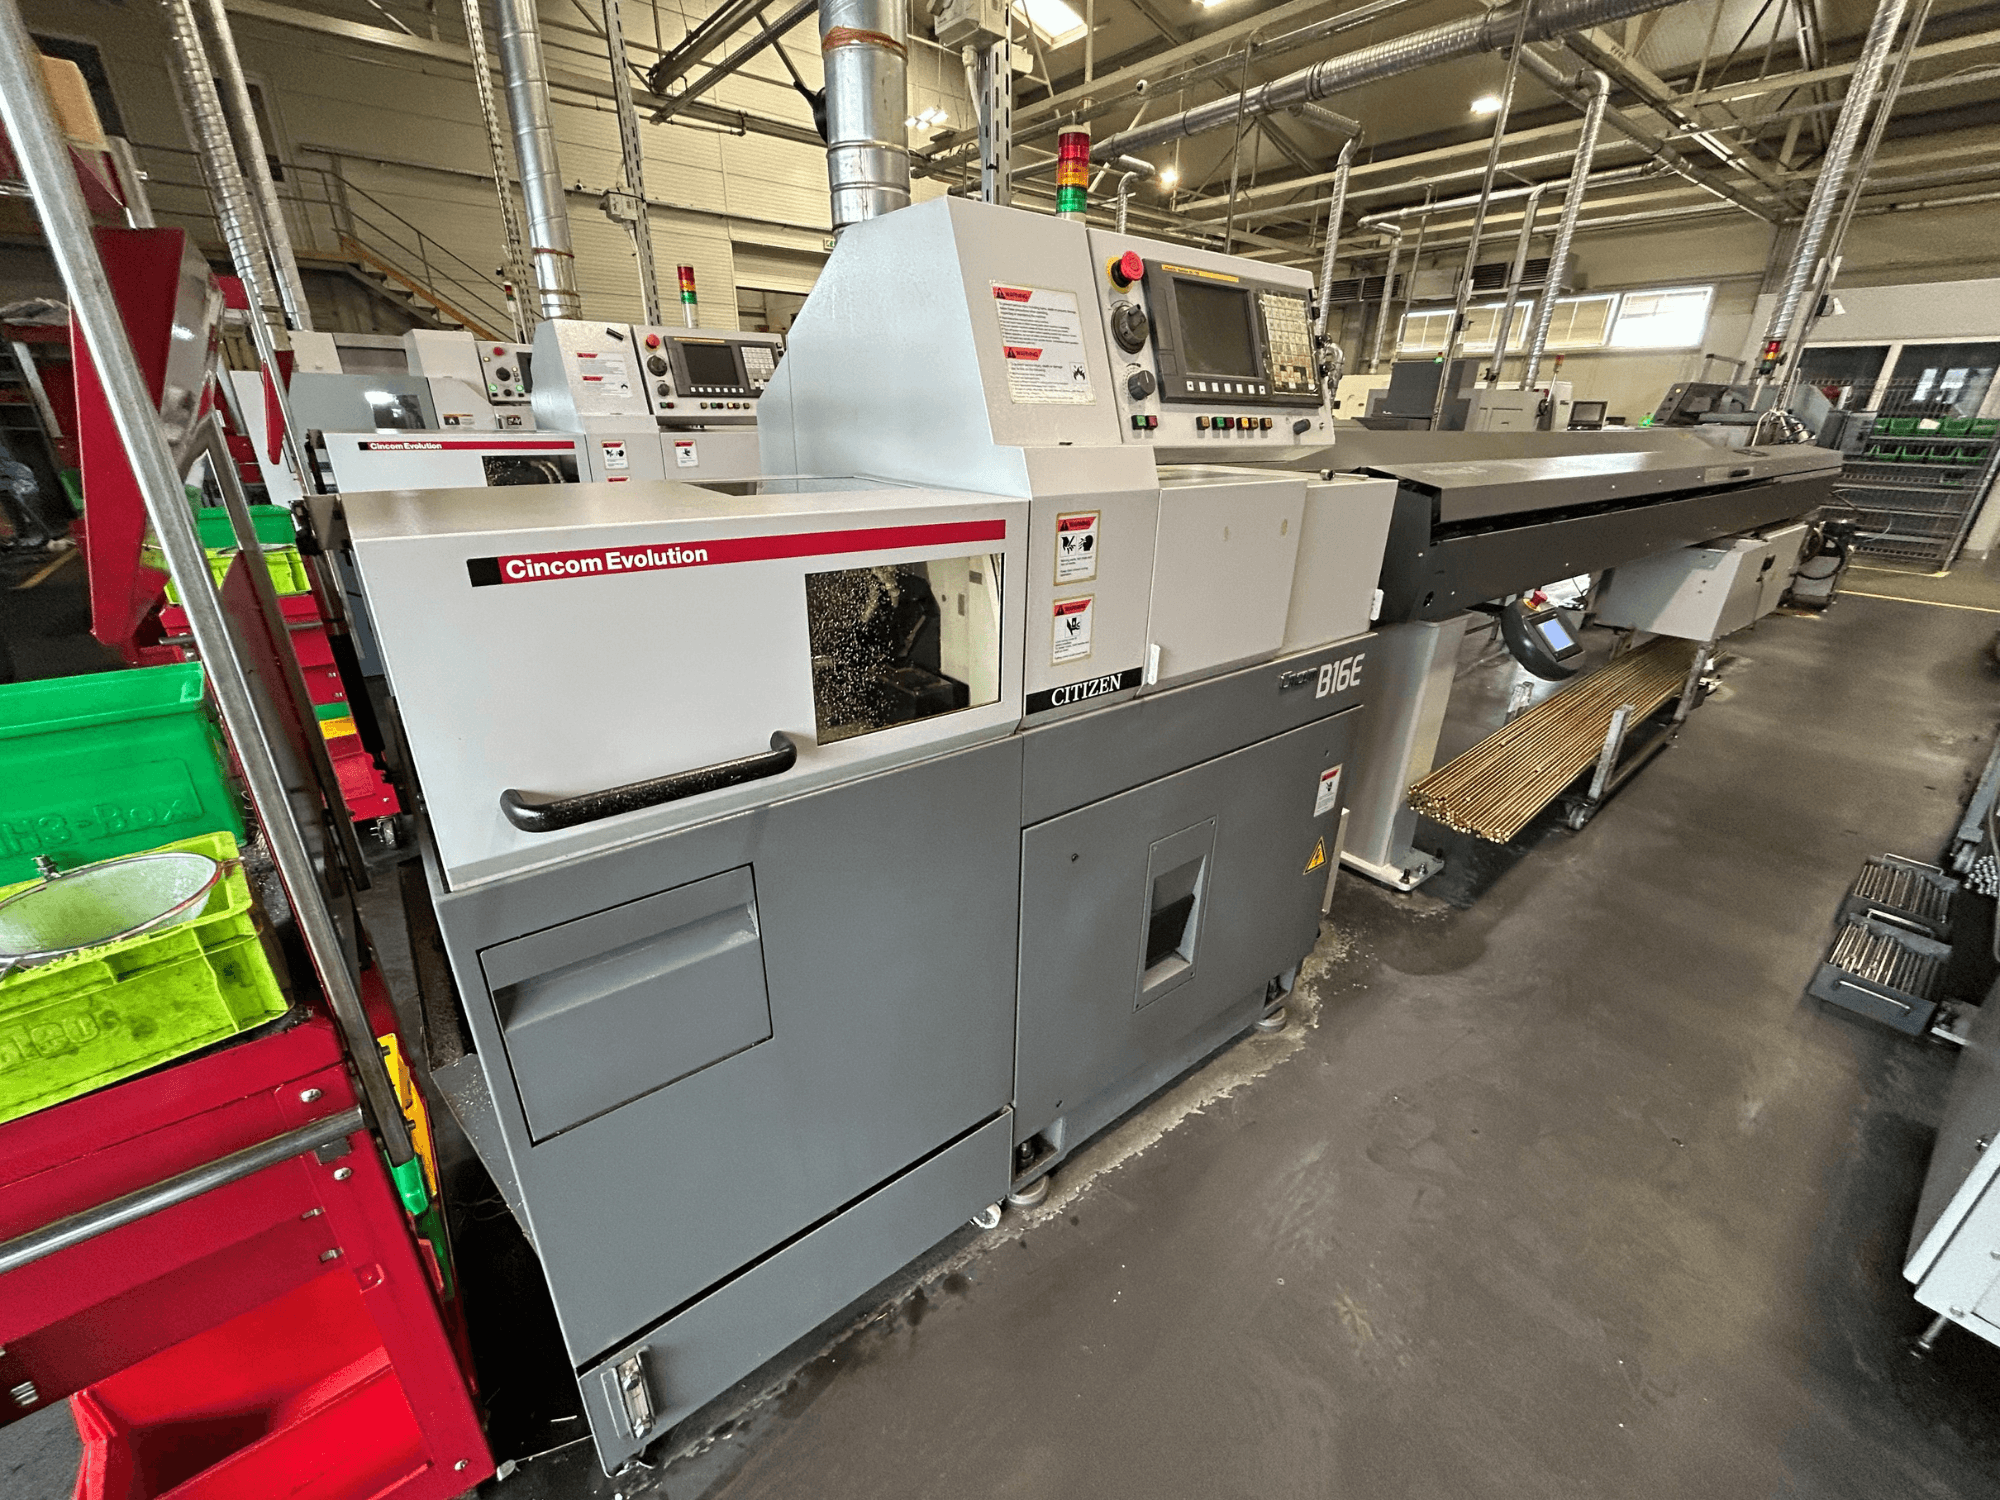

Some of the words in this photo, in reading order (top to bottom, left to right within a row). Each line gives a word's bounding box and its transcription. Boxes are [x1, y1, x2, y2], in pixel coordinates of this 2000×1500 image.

[370, 442, 403, 450] Cincom
[403, 442, 443, 450] Evolution
[506, 557, 603, 579] Cincom
[605, 547, 708, 570] Evolution
[1051, 673, 1123, 706] CITIZEN
[1315, 653, 1366, 699] B16E
